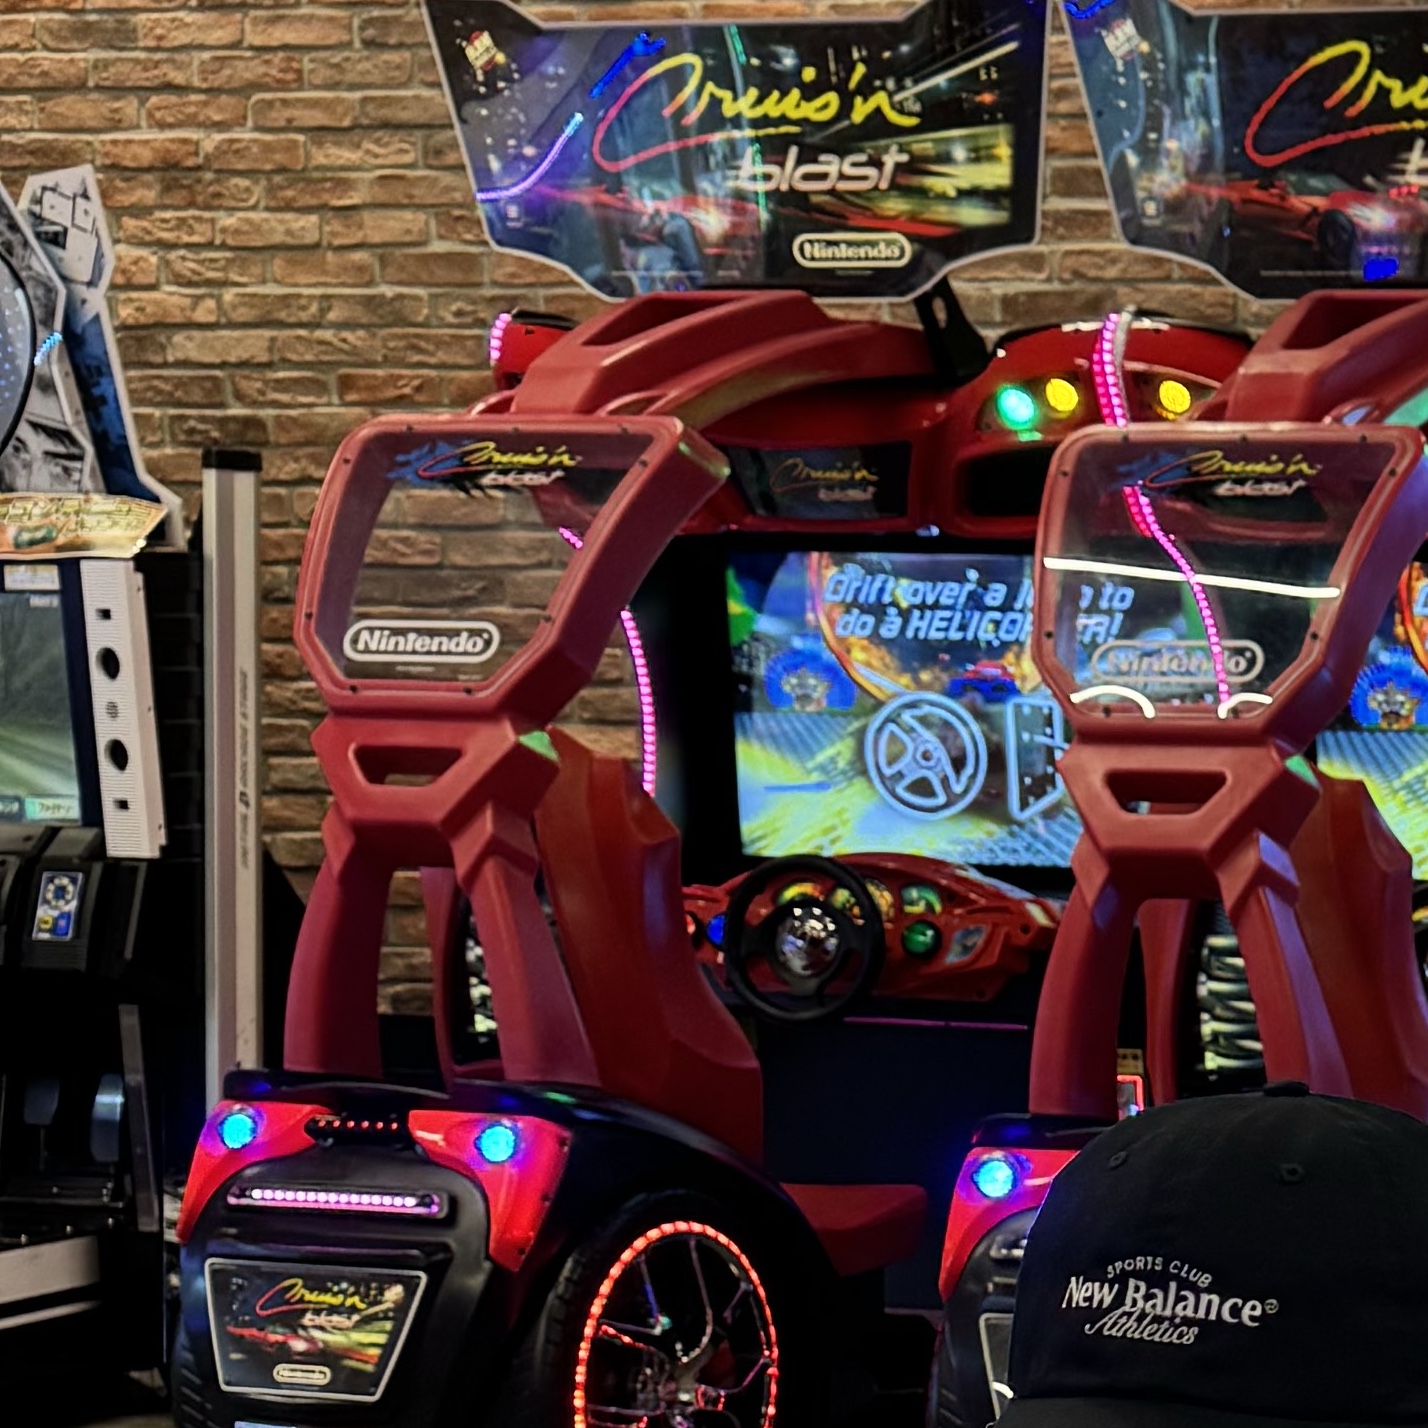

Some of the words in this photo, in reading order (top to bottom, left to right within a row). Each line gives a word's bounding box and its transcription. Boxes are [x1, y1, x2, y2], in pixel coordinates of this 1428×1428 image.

[591, 53, 919, 172] Cruis'n
[728, 146, 908, 191] blast
[802, 239, 901, 262] Nintendo
[898, 580, 973, 604] over
[985, 582, 1007, 604] a
[836, 610, 874, 639] do
[357, 630, 489, 653] Nintendo
[1107, 1256, 1163, 1279] SPORTS
[1169, 1260, 1212, 1288] CLUB
[1062, 1276, 1119, 1309] New
[1085, 1307, 1198, 1344] Athletics
